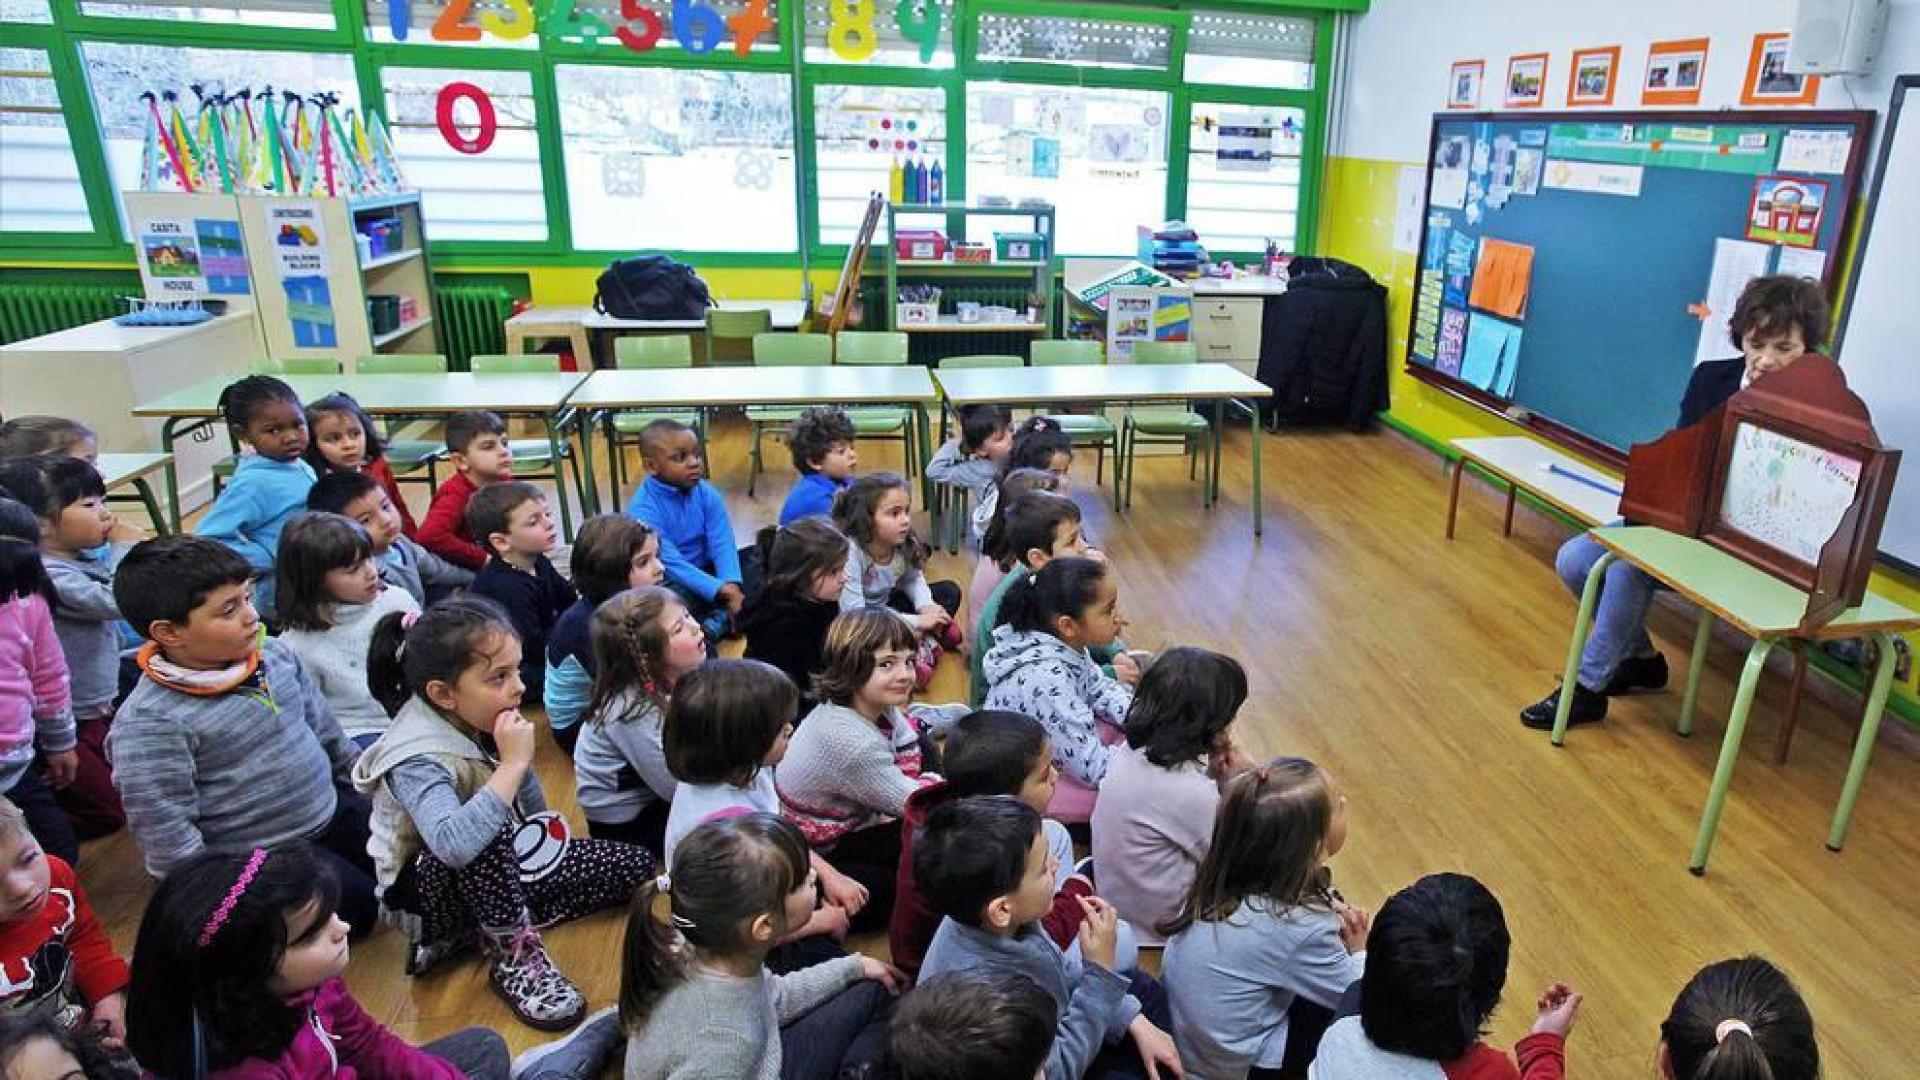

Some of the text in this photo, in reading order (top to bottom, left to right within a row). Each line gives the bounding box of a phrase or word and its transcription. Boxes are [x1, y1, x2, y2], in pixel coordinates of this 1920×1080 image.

[616, 0, 662, 52] 5
[672, 0, 725, 54] 6
[827, 0, 877, 61] 8
[897, 0, 940, 63] 9
